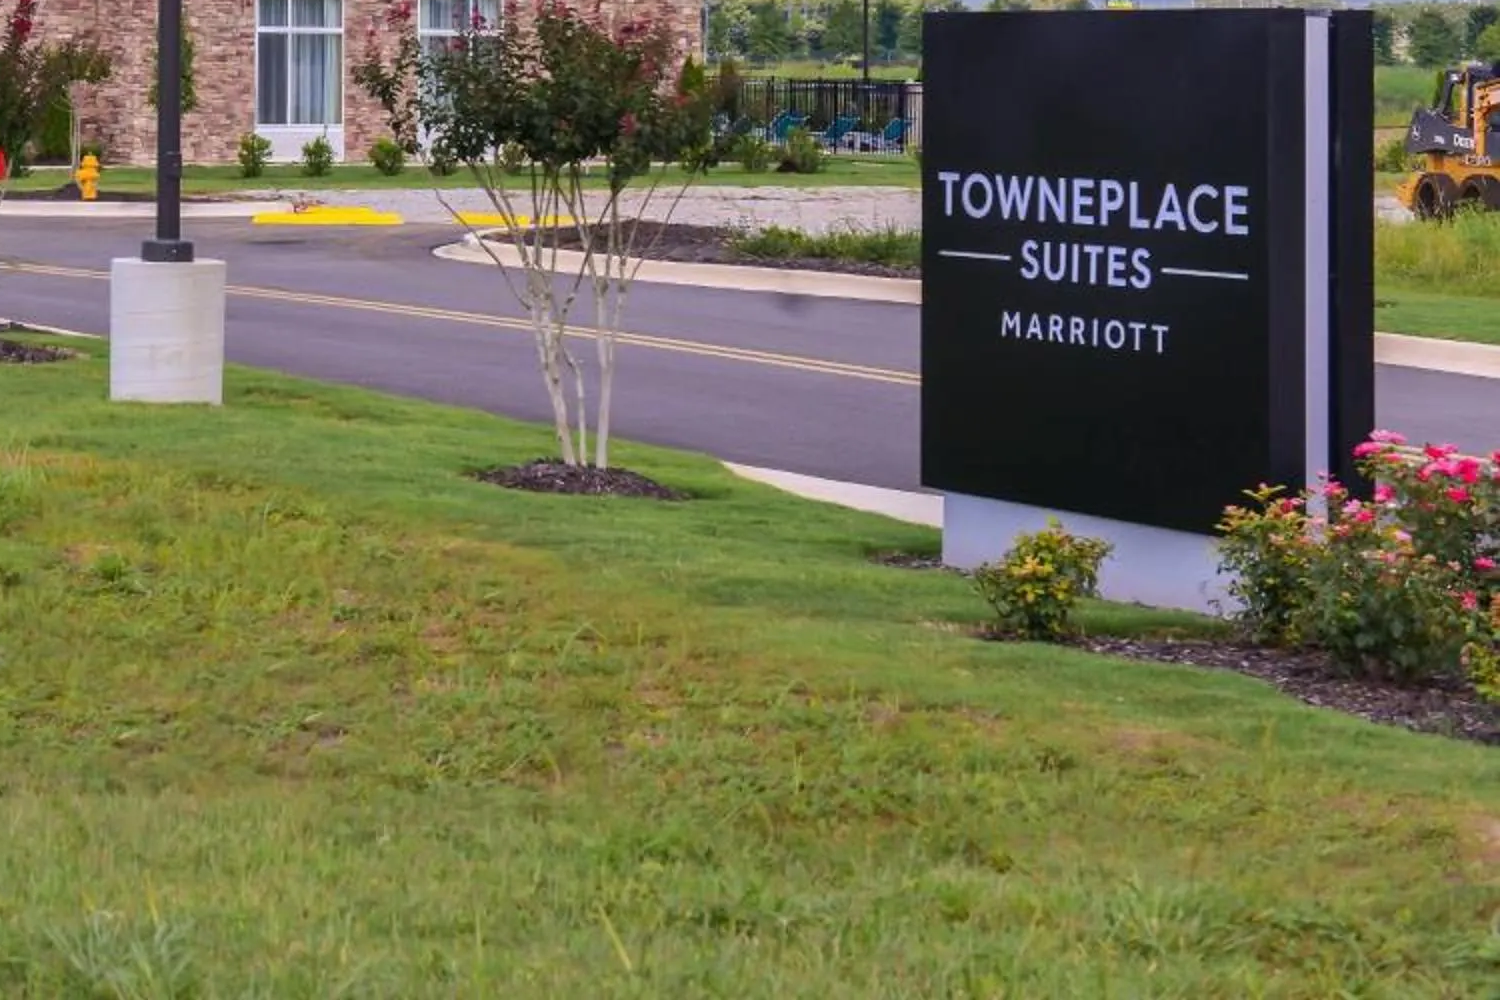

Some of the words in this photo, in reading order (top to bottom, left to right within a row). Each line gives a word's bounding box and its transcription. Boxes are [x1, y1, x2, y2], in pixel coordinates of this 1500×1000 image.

[938, 171, 1249, 235] TOWNEPLACE
[1020, 239, 1152, 290] SUITES
[1001, 311, 1169, 354] MARRIOTT
